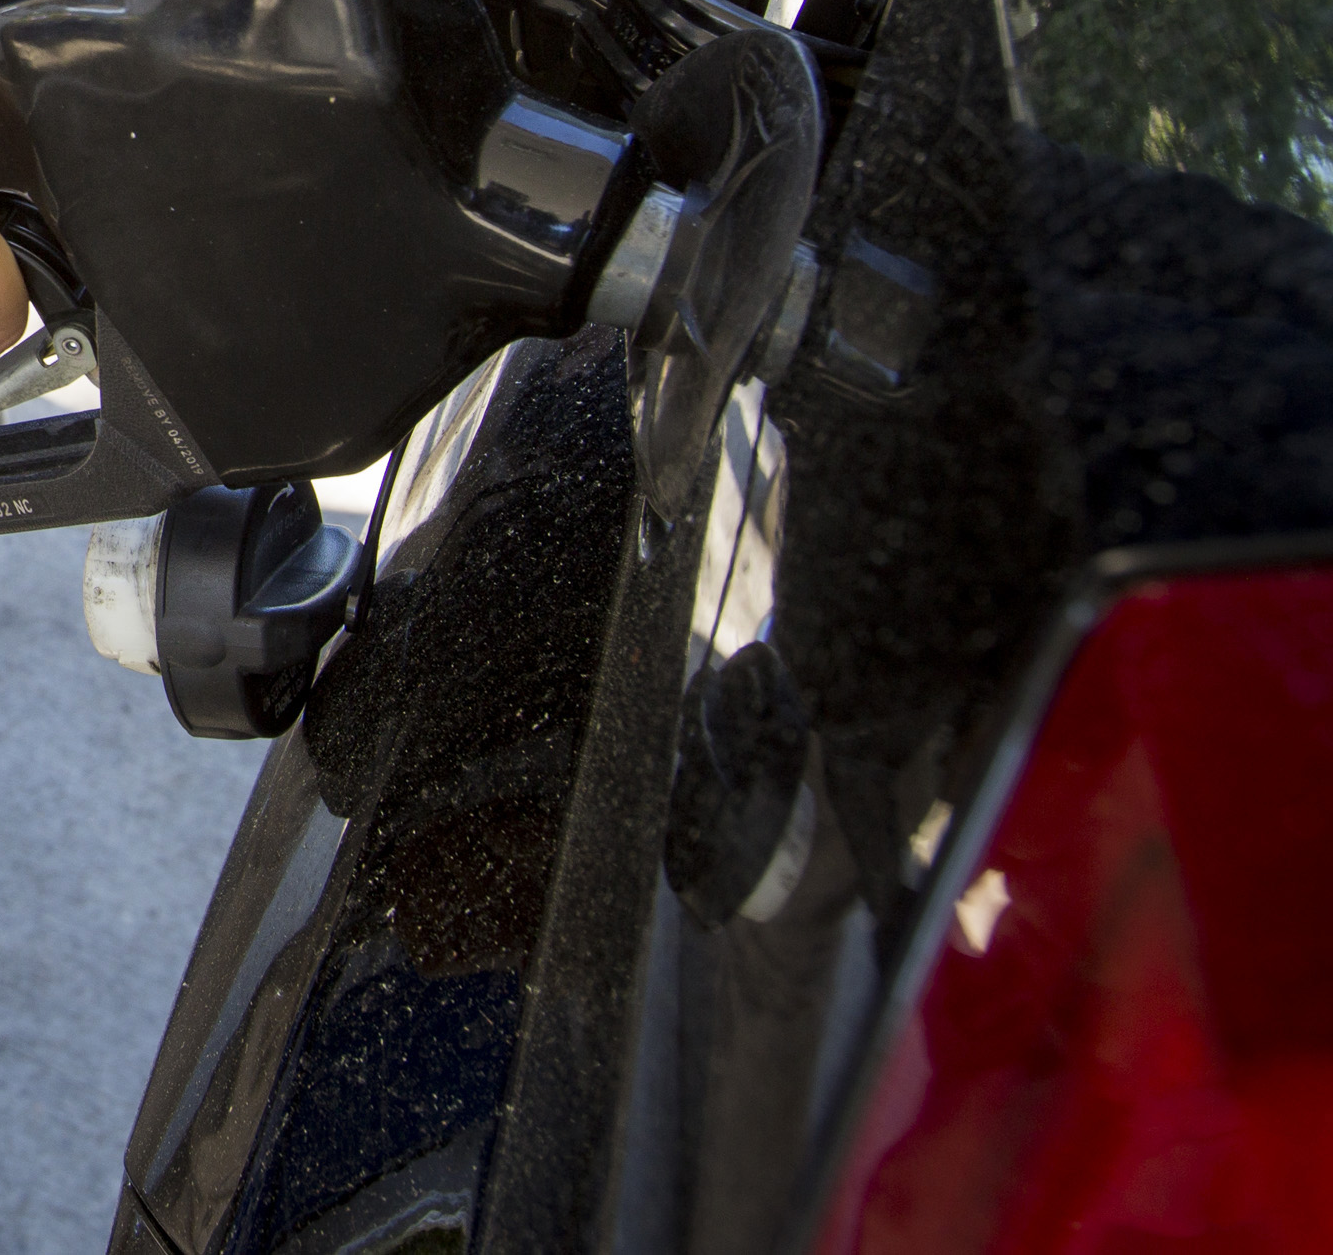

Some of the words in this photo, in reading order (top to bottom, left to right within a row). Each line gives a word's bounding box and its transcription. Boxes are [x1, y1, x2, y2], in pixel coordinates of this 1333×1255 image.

[154, 409, 172, 425] BY
[168, 429, 204, 475] 04/2019
[12, 498, 33, 515] NC
